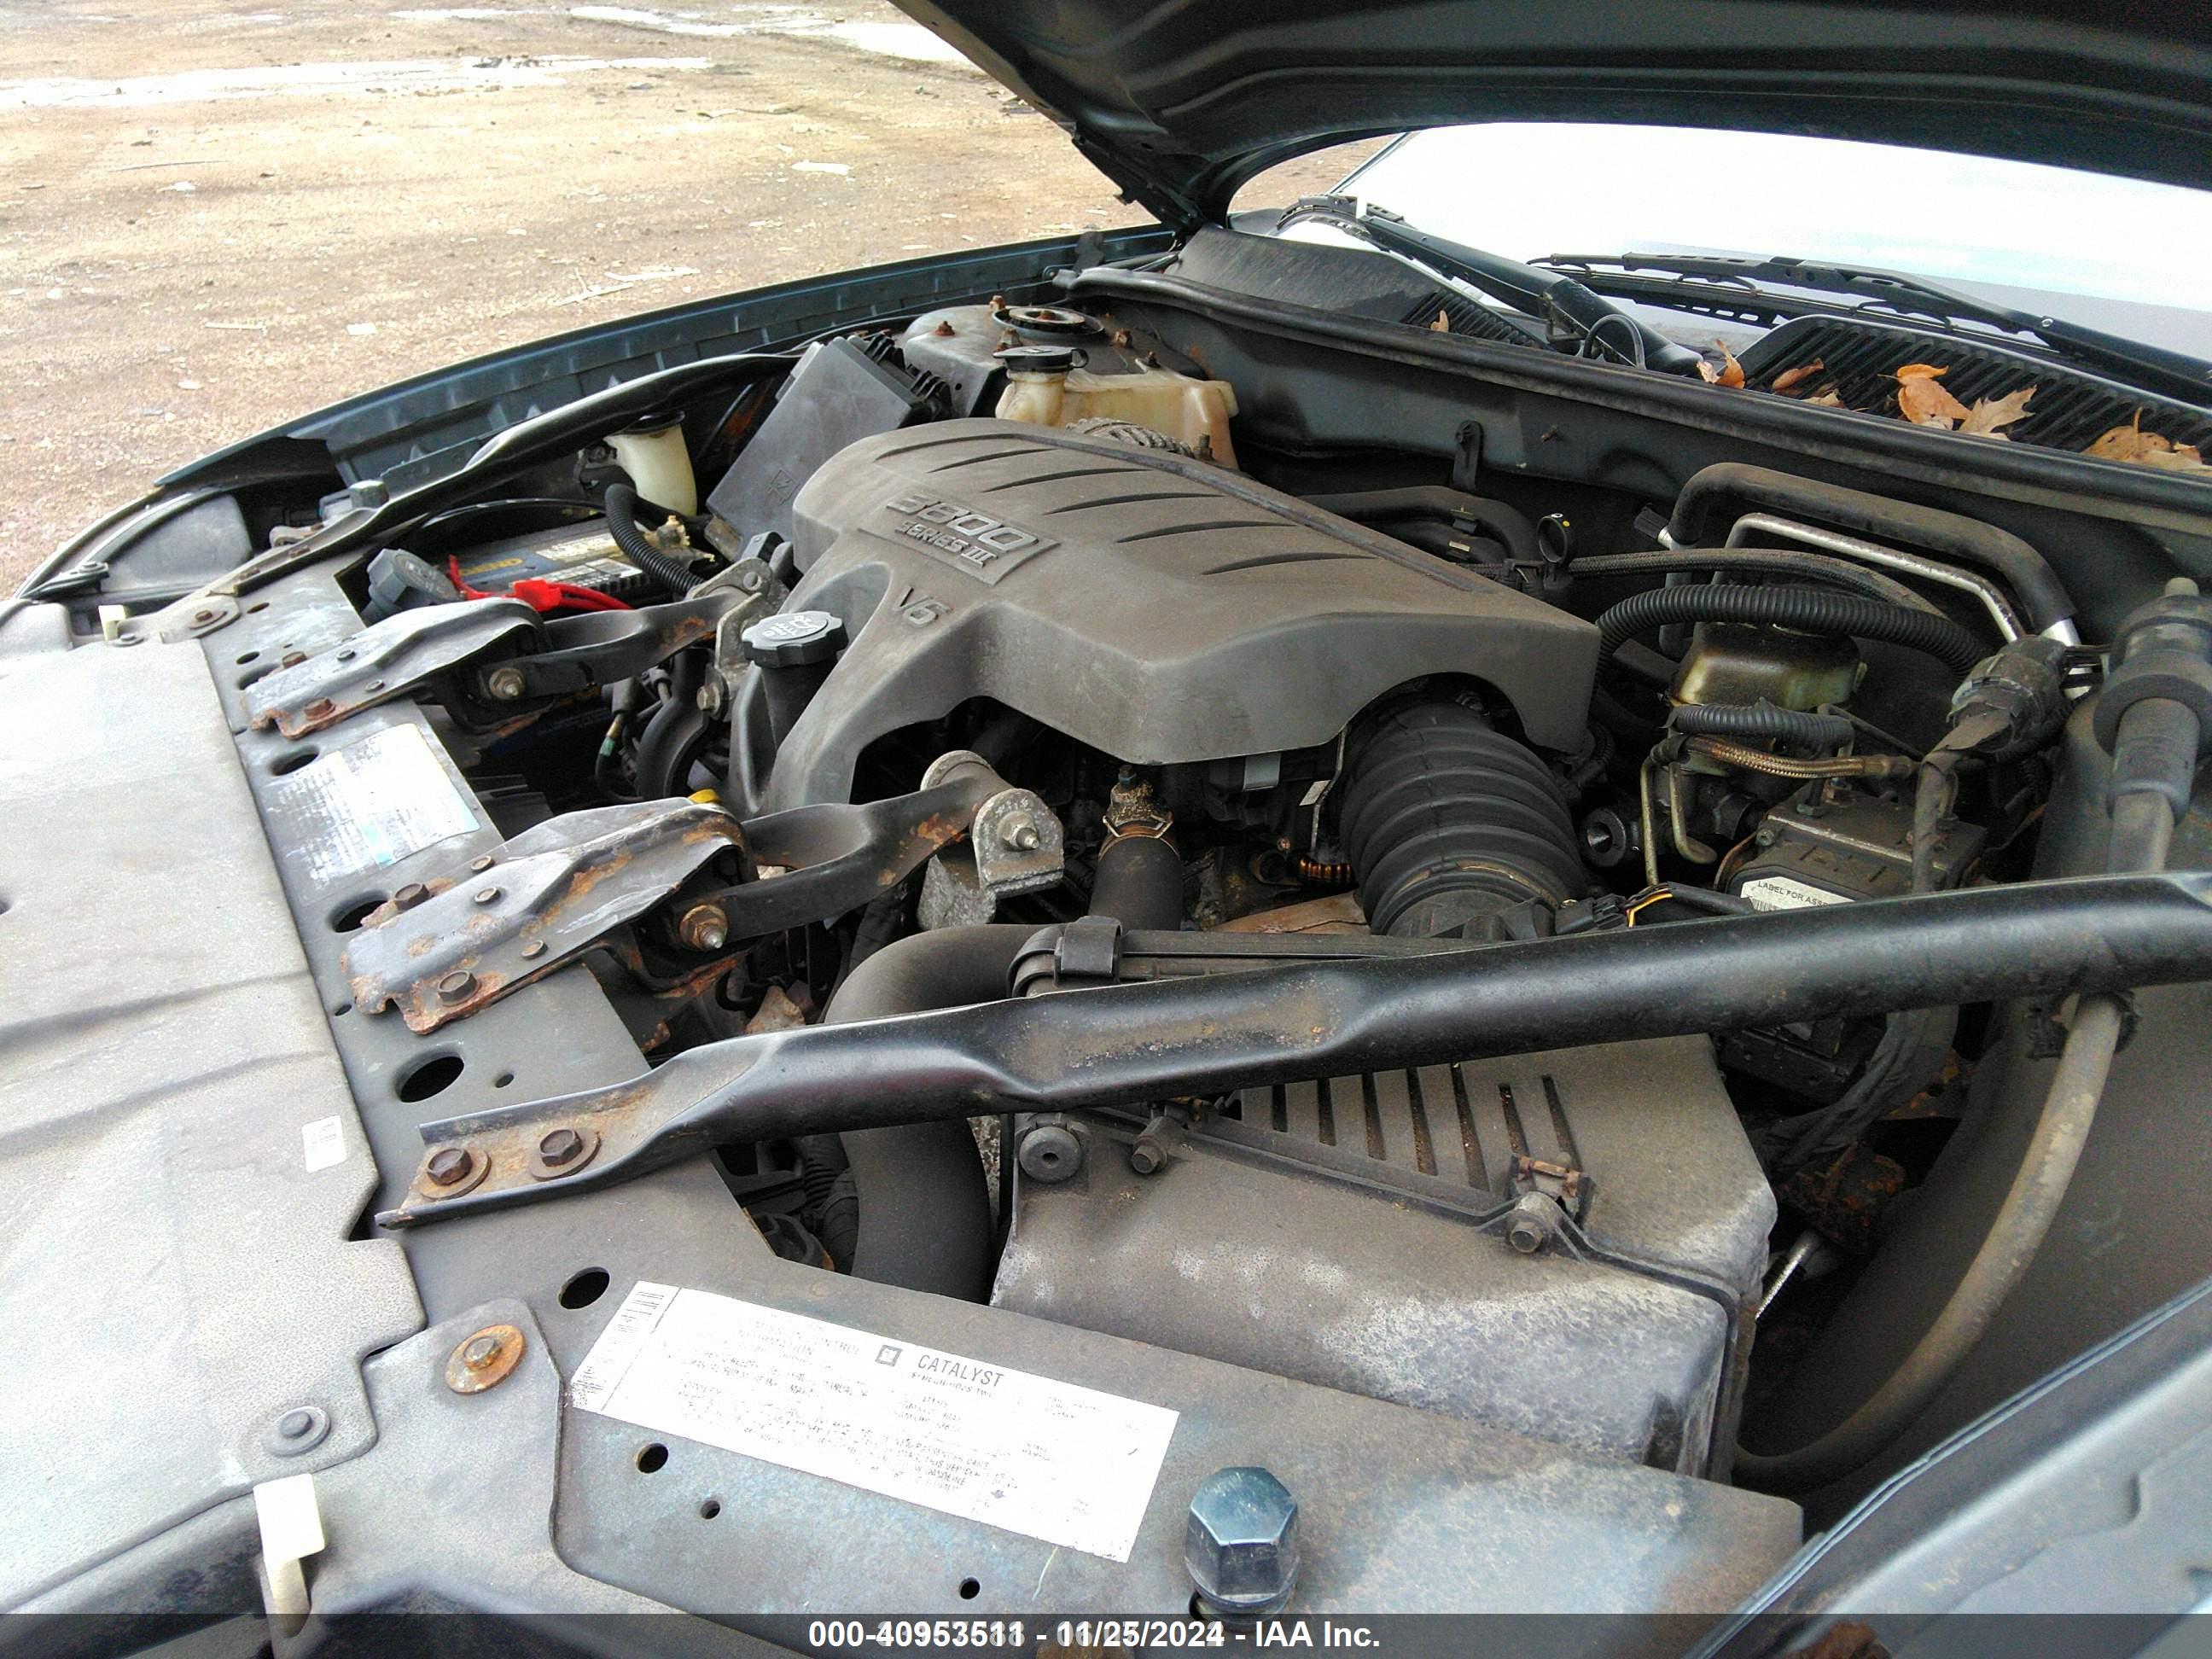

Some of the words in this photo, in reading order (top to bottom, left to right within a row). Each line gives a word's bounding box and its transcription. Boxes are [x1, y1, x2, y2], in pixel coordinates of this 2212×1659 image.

[886, 495, 1039, 554] 3800
[894, 520, 970, 553] SERIES
[961, 546, 998, 568] III
[894, 585, 953, 628] V6
[1758, 880, 1784, 894] LABEL
[1785, 890, 1804, 902] FOR
[917, 1354, 1004, 1387] CATALYST
